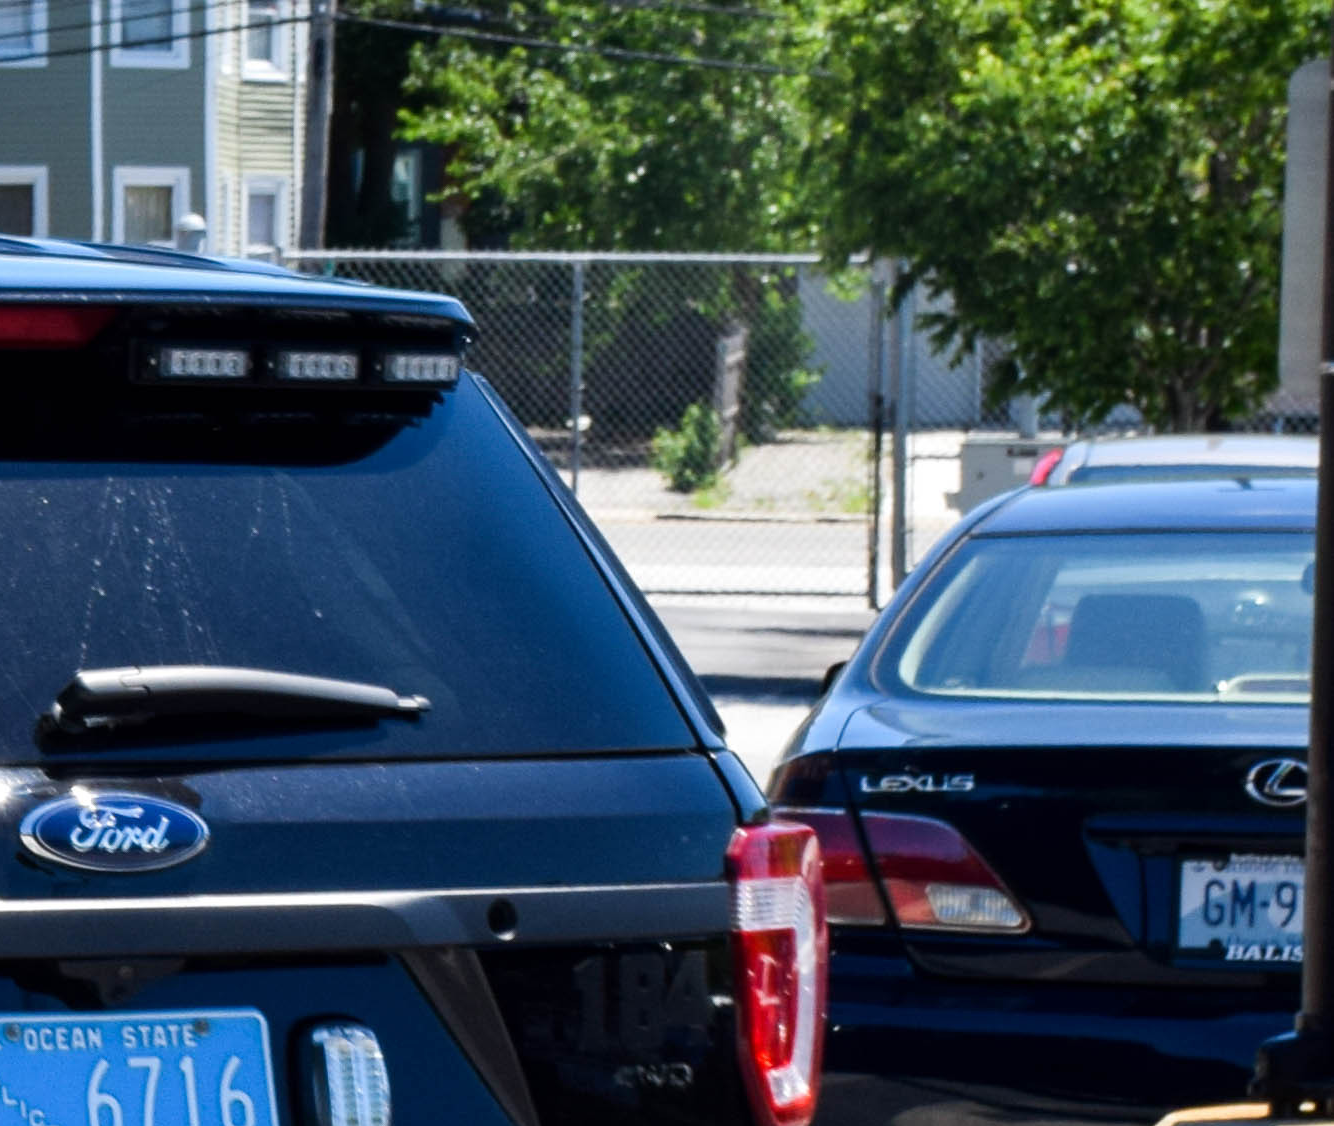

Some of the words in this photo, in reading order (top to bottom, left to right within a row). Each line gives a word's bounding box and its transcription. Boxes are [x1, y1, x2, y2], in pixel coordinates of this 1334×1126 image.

[861, 774, 975, 793] LEXUS
[70, 804, 171, 854] Ford
[23, 1027, 103, 1051] OCEAN
[122, 1024, 199, 1049] STATE
